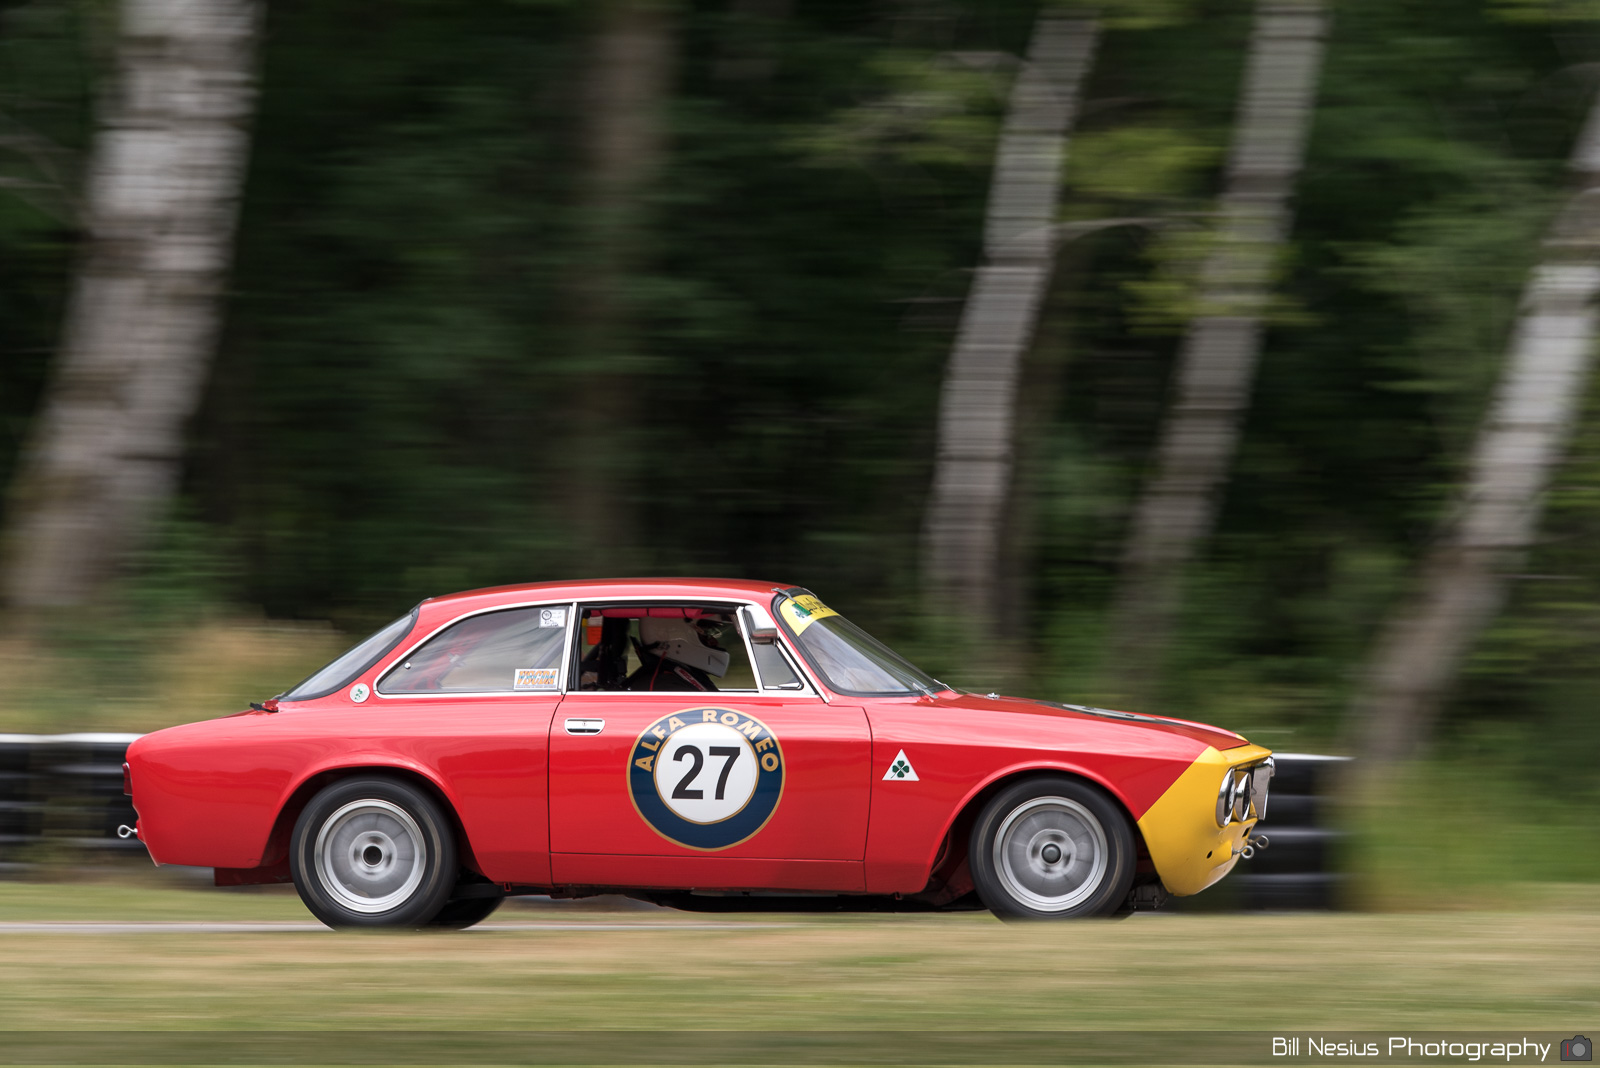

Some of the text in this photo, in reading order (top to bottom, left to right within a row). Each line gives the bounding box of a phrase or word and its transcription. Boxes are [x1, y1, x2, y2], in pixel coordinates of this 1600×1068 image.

[635, 710, 779, 772] ALFA ROMEO
[671, 744, 741, 801] 27
